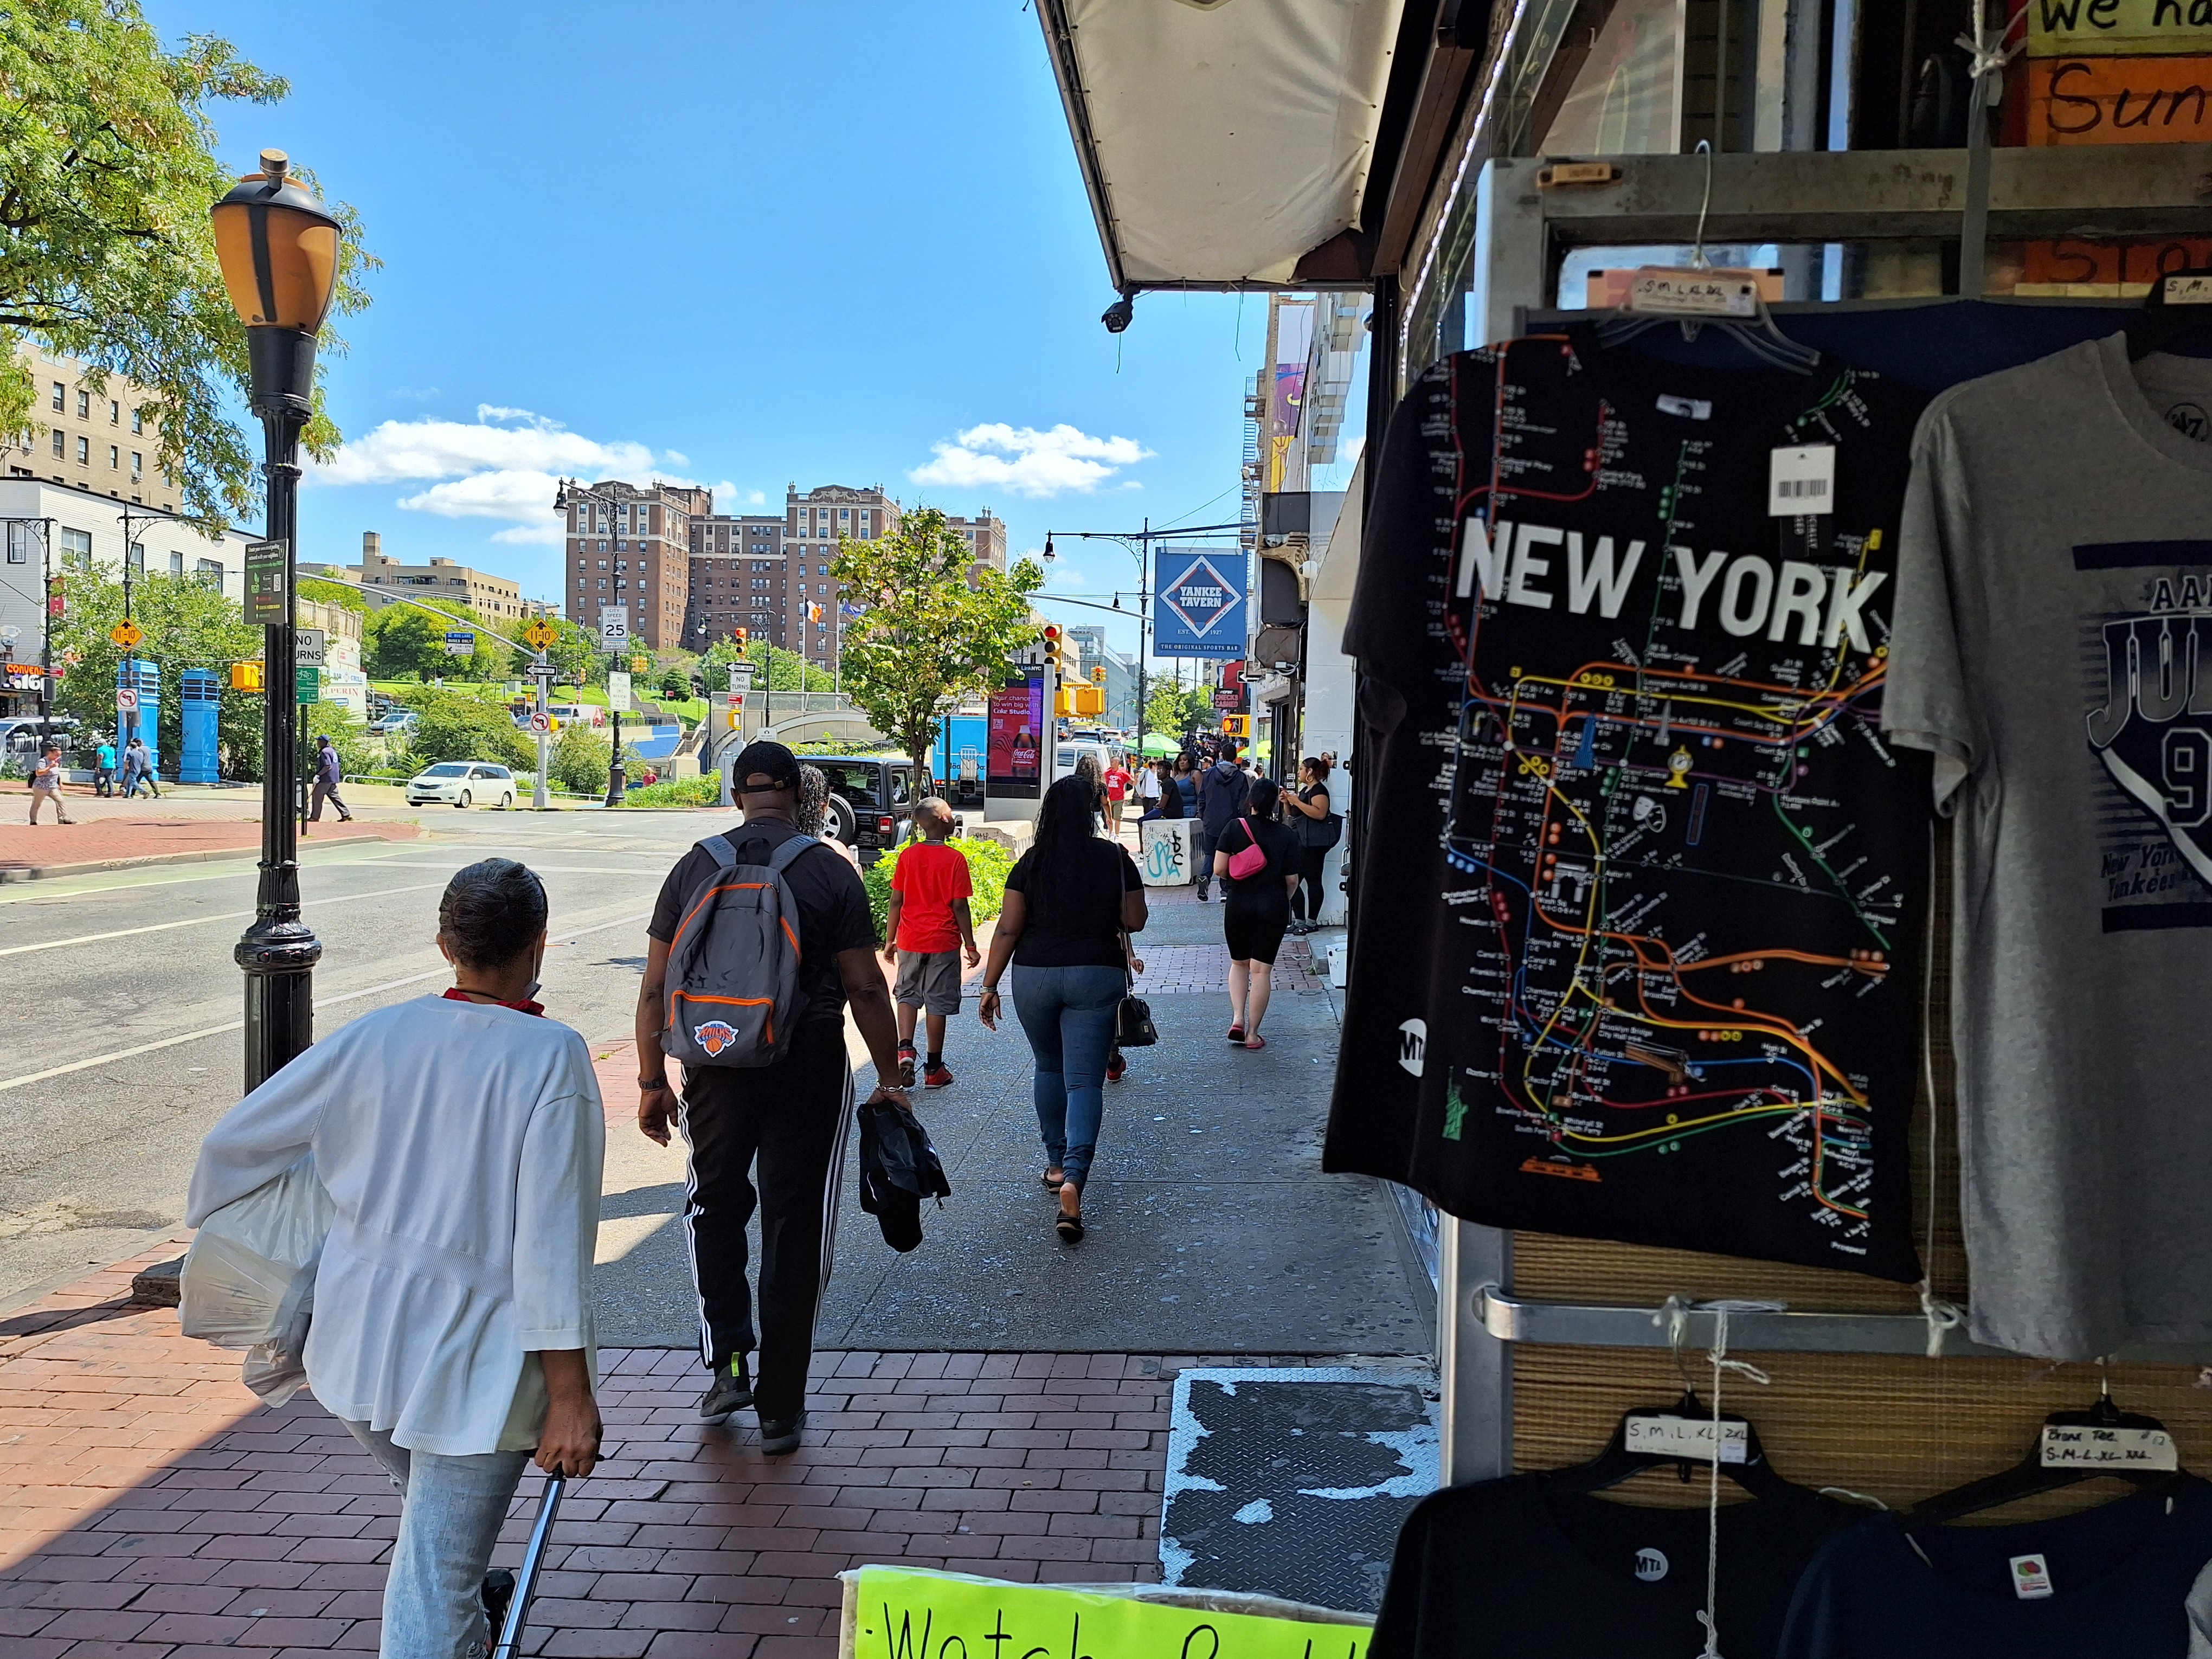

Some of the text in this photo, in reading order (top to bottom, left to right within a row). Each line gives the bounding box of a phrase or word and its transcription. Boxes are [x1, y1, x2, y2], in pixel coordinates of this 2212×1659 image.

[1456, 516, 1888, 654] NEW YORK
[1180, 586, 1222, 597] YANKEE
[2150, 577, 2212, 614] AA
[1180, 597, 1222, 608] TAVERN
[606, 624, 625, 636] 25
[296, 635, 312, 646] NO
[296, 651, 321, 660] URNS
[697, 1026, 733, 1041] KNICKS
